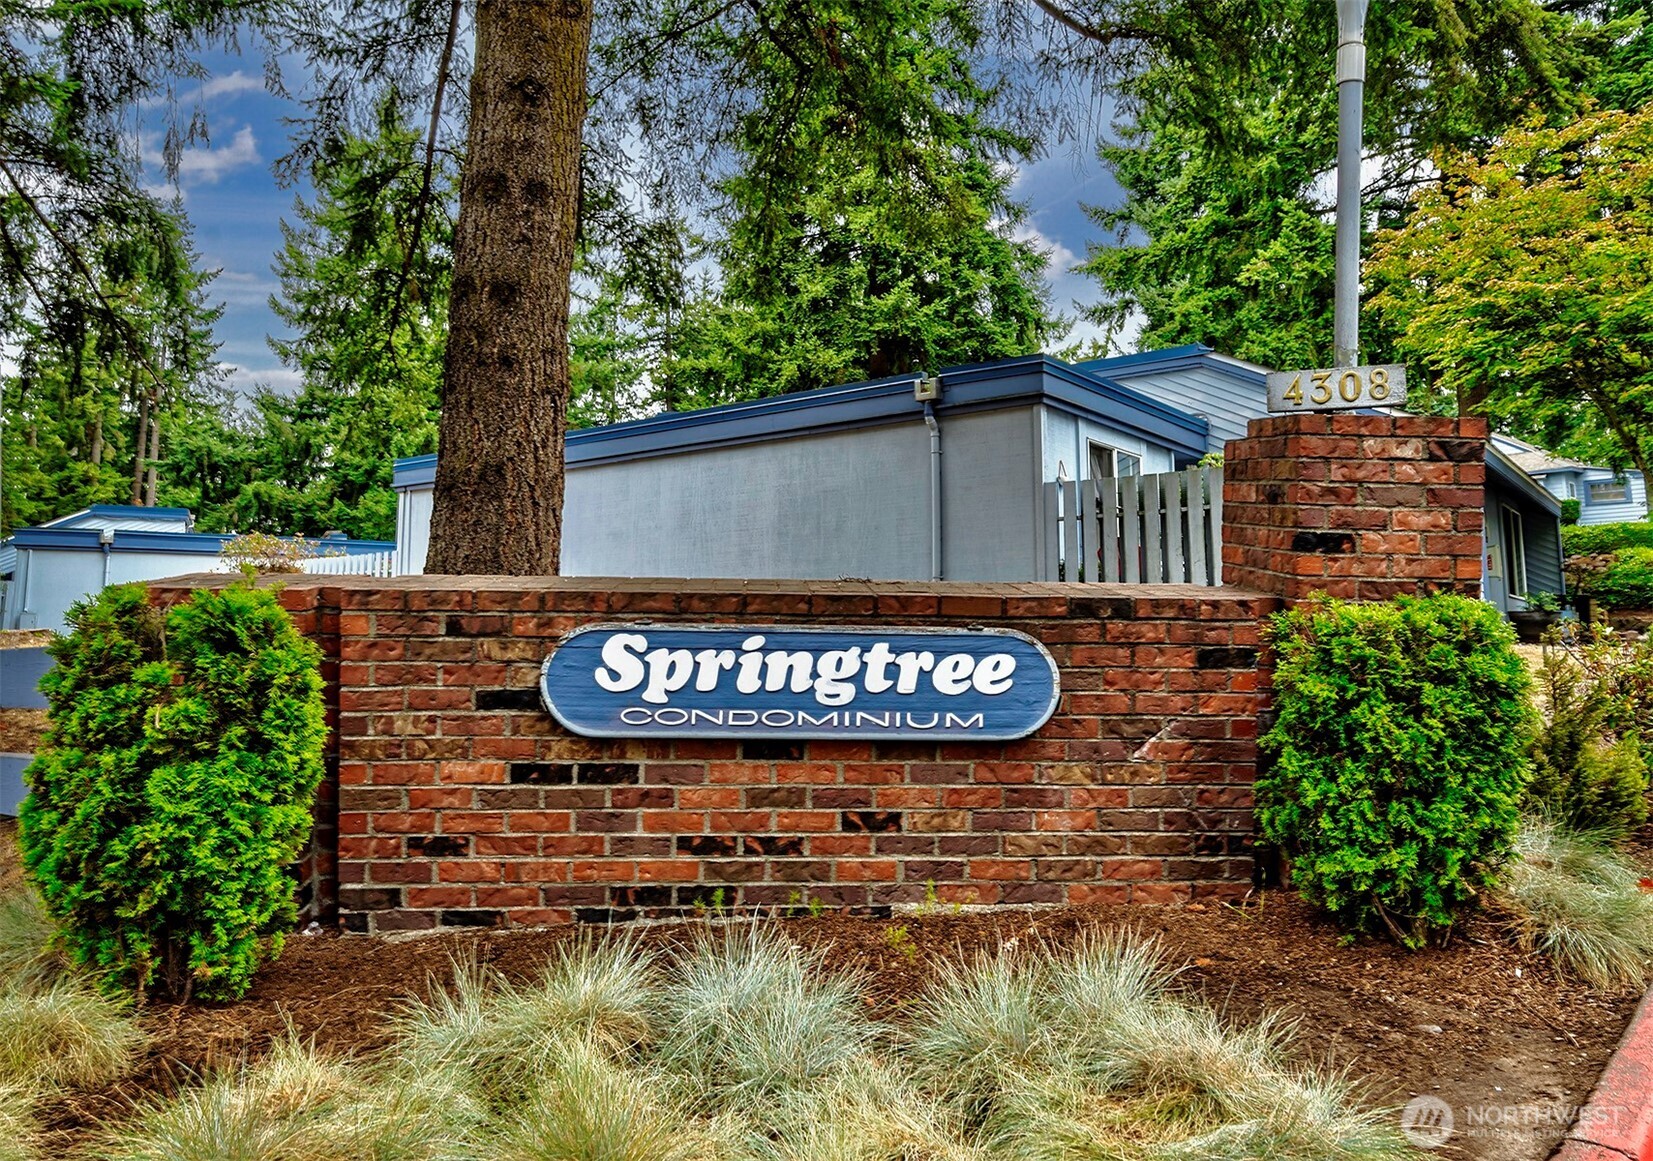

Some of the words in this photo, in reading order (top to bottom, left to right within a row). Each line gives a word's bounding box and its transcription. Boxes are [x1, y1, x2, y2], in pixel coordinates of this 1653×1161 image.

[1283, 368, 1391, 405] 4308
[594, 632, 1016, 706] Springtree
[620, 707, 985, 728] CONDOMINIUM
